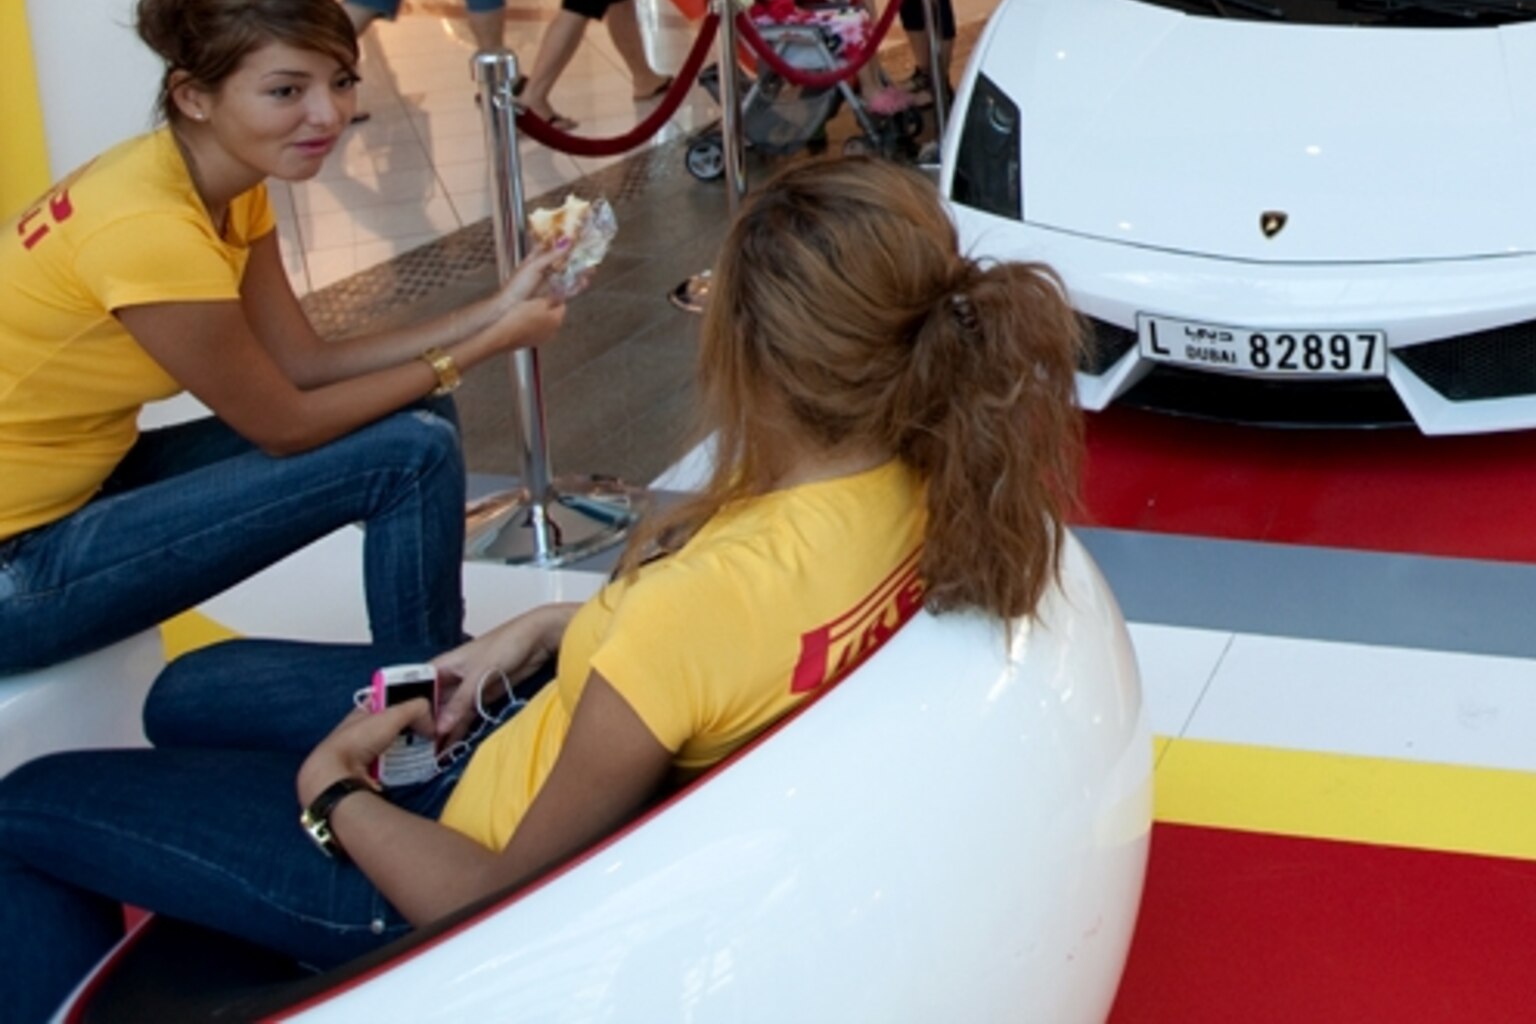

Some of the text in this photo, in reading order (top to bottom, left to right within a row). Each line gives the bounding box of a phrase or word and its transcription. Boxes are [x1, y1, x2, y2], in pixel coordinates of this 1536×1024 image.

[1148, 320, 1378, 371] L DUBAI 82897
